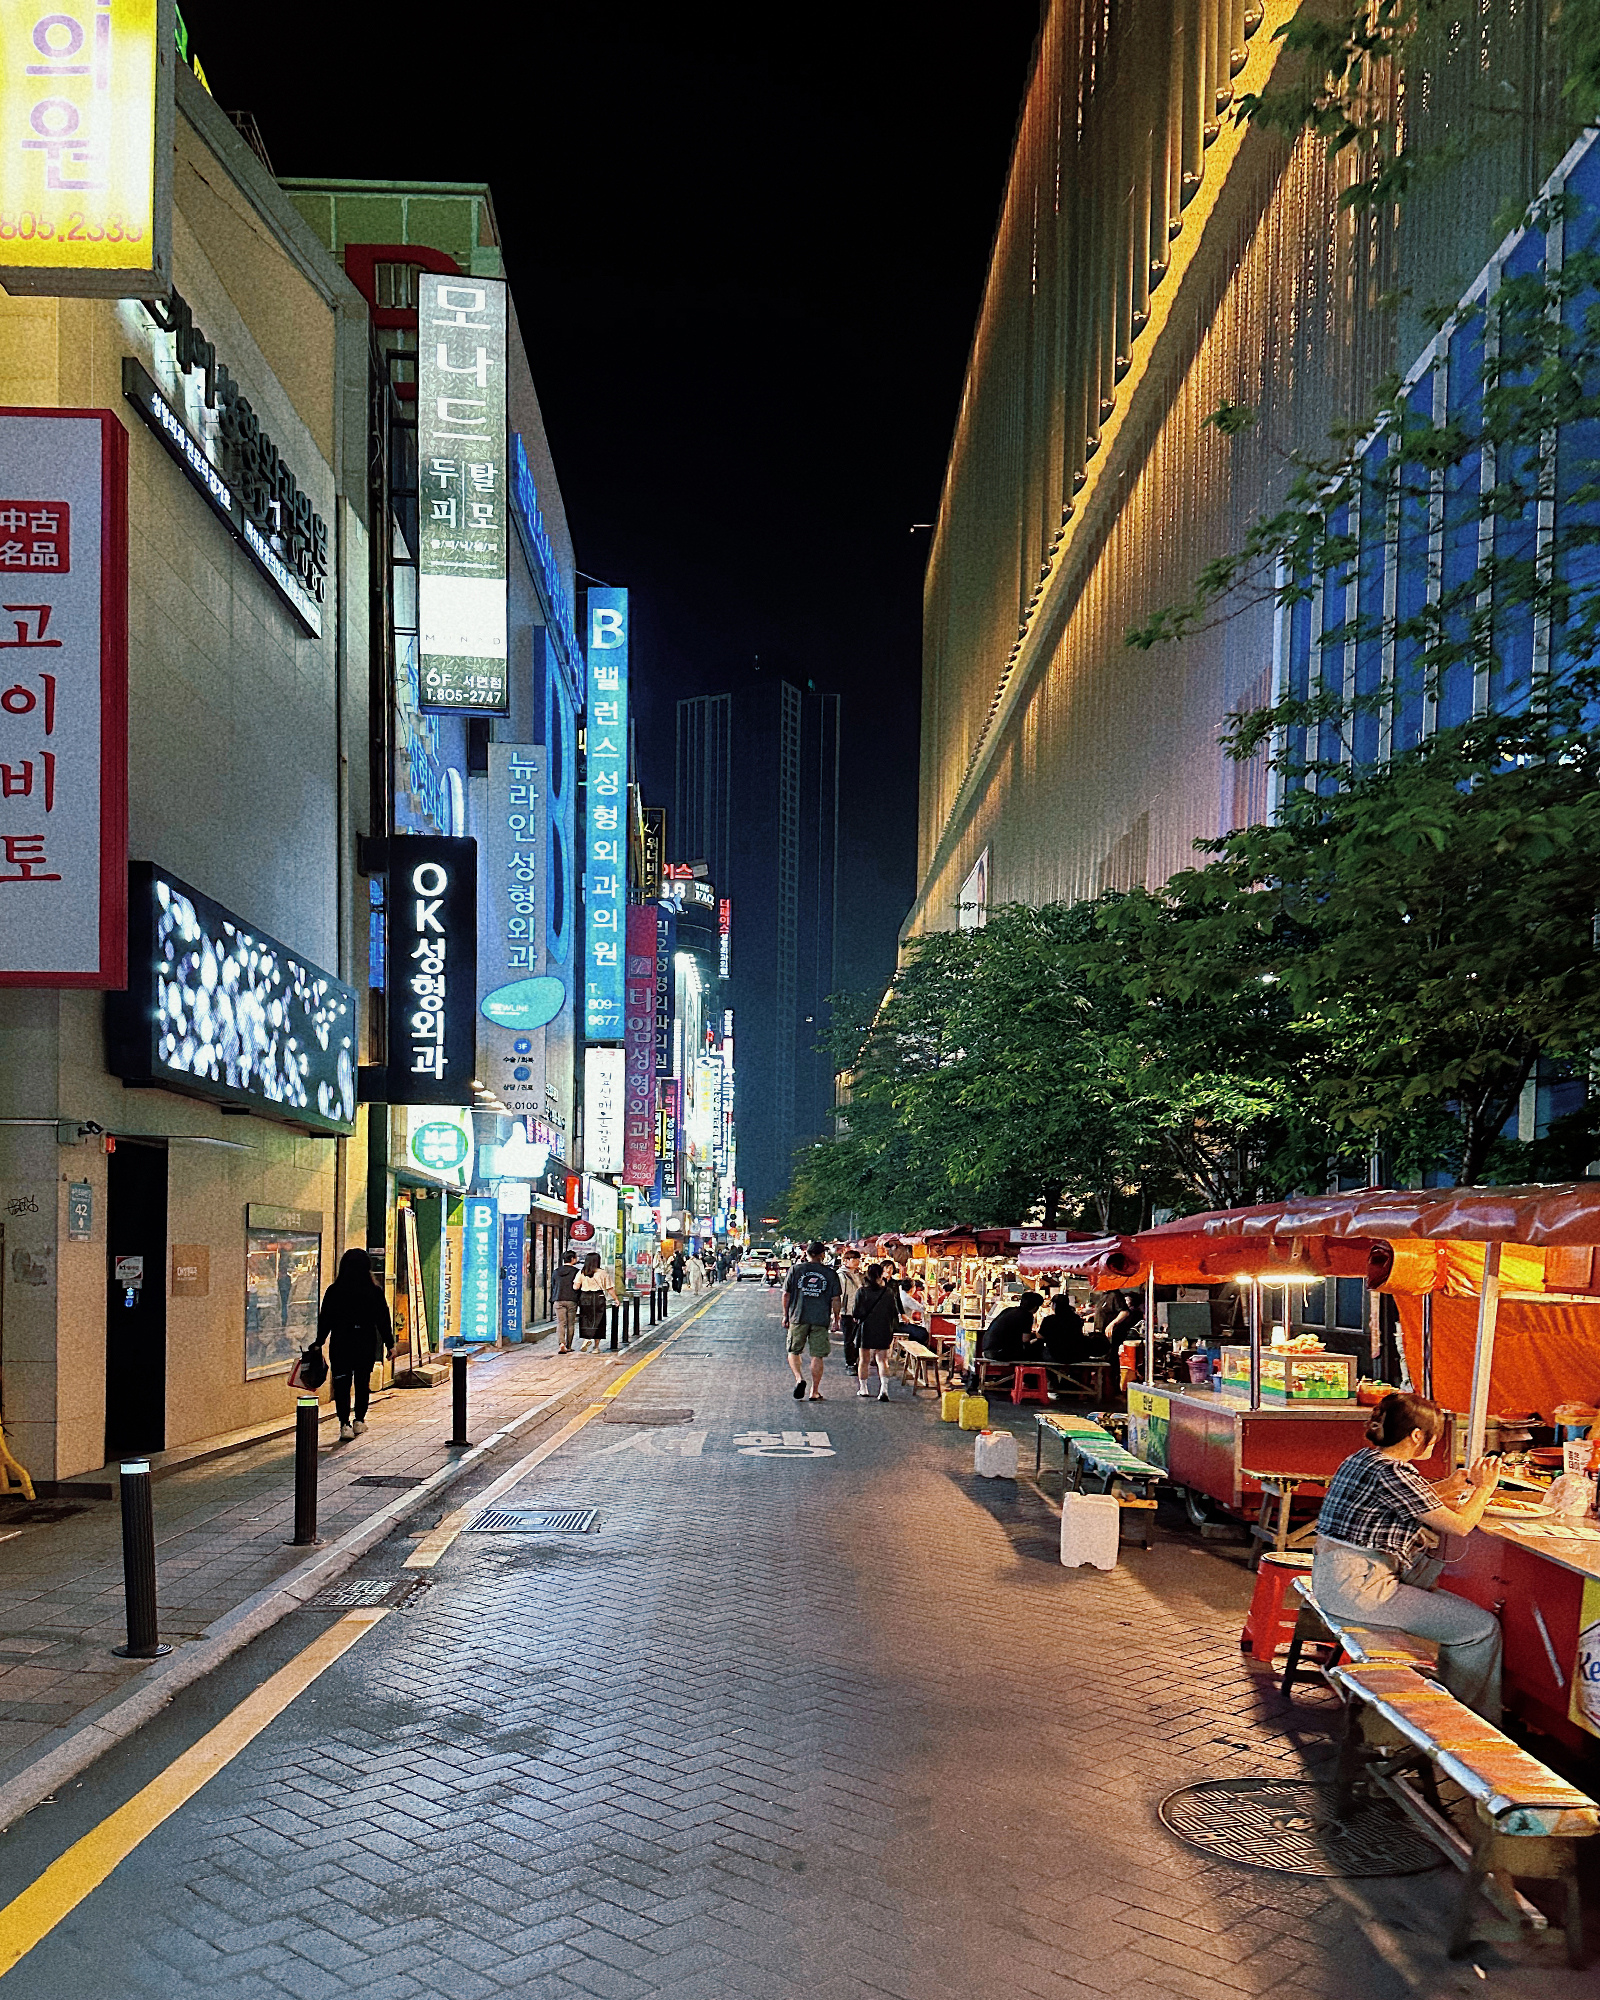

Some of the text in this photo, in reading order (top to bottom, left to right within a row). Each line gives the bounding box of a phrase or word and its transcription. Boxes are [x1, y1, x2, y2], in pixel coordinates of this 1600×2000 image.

[21, 0, 111, 191] 의원
[432, 284, 495, 441] 모나드
[429, 458, 499, 531] 두피 탈모
[0, 508, 60, 534] 中古
[0, 540, 59, 567] 名品
[425, 634, 501, 645] MND
[590, 608, 626, 650] B
[426, 667, 502, 689] 6F 서면점
[426, 688, 502, 704] T.805-2747
[0, 604, 63, 882] 고이비토
[507, 752, 540, 972] 뉴라인 성형외과
[588, 1015, 619, 1026] 9677
[628, 987, 655, 1140] 타임성형외과
[75, 1204, 88, 1216] 42
[474, 1206, 492, 1228] B
